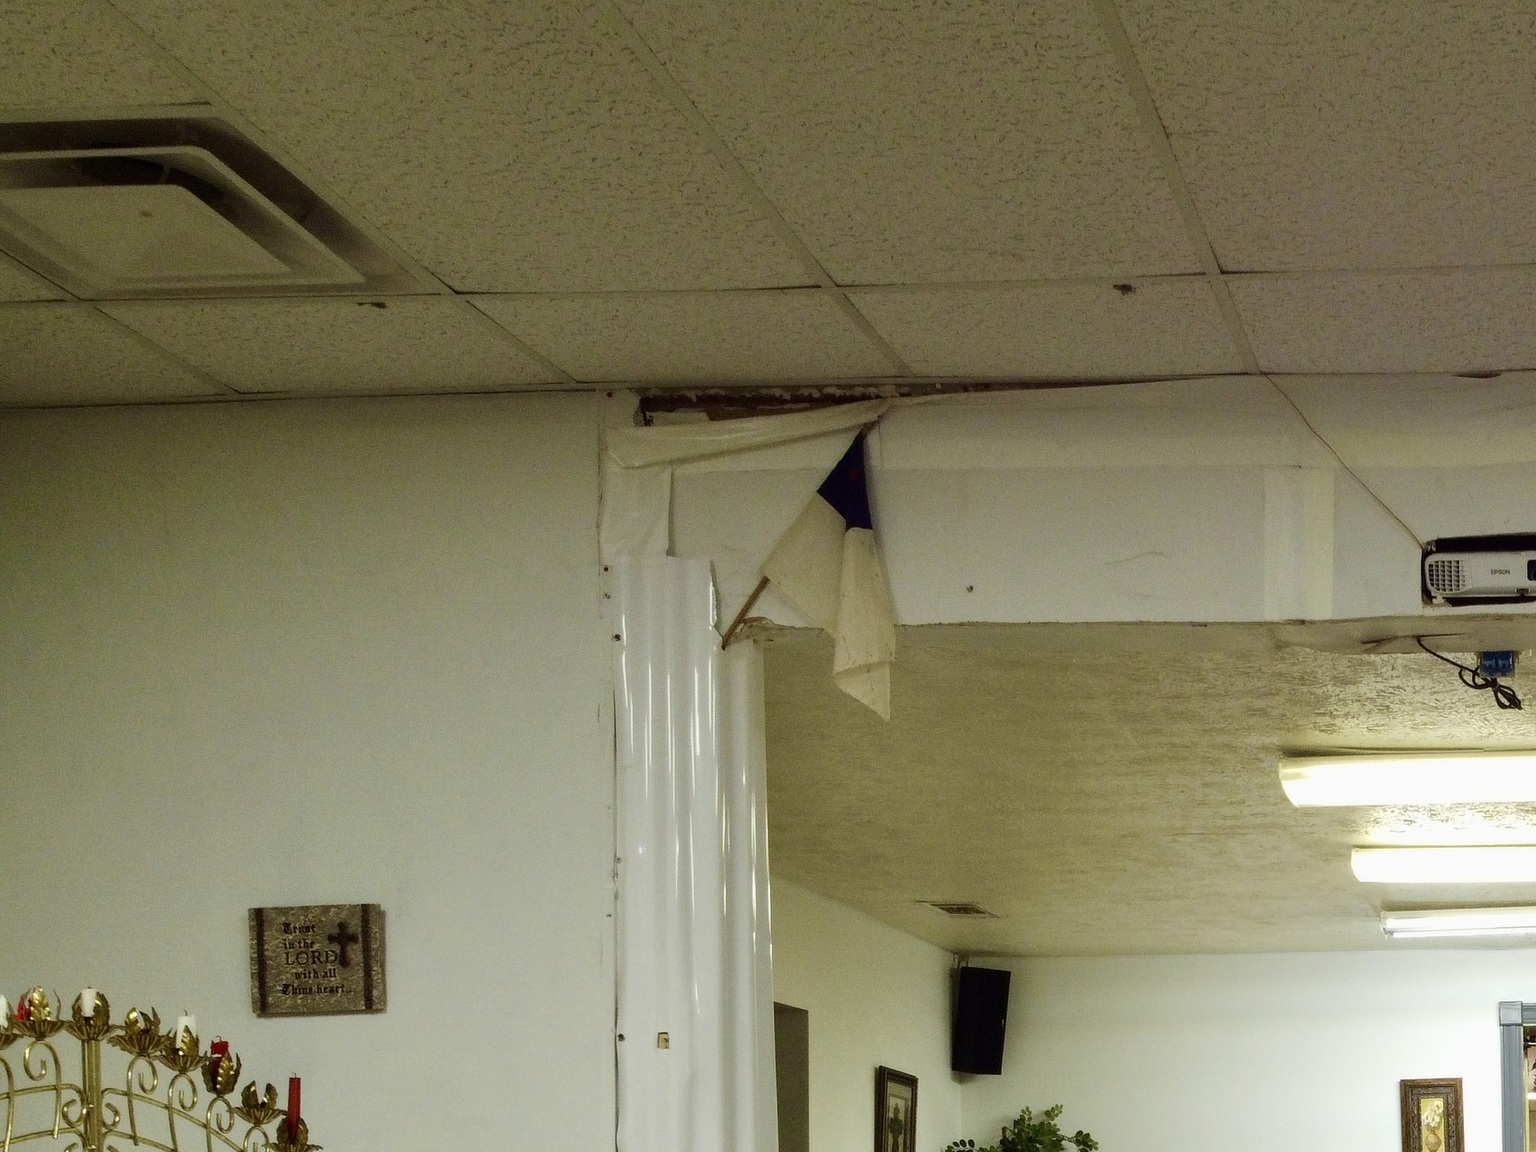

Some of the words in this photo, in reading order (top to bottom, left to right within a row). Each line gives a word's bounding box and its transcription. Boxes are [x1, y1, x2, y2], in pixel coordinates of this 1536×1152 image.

[282, 922, 316, 935] Trust
[283, 938, 296, 950] in
[298, 937, 315, 949] the
[284, 950, 338, 966] LORD
[294, 968, 320, 980] with
[322, 967, 338, 979] all
[281, 983, 314, 996] Thine
